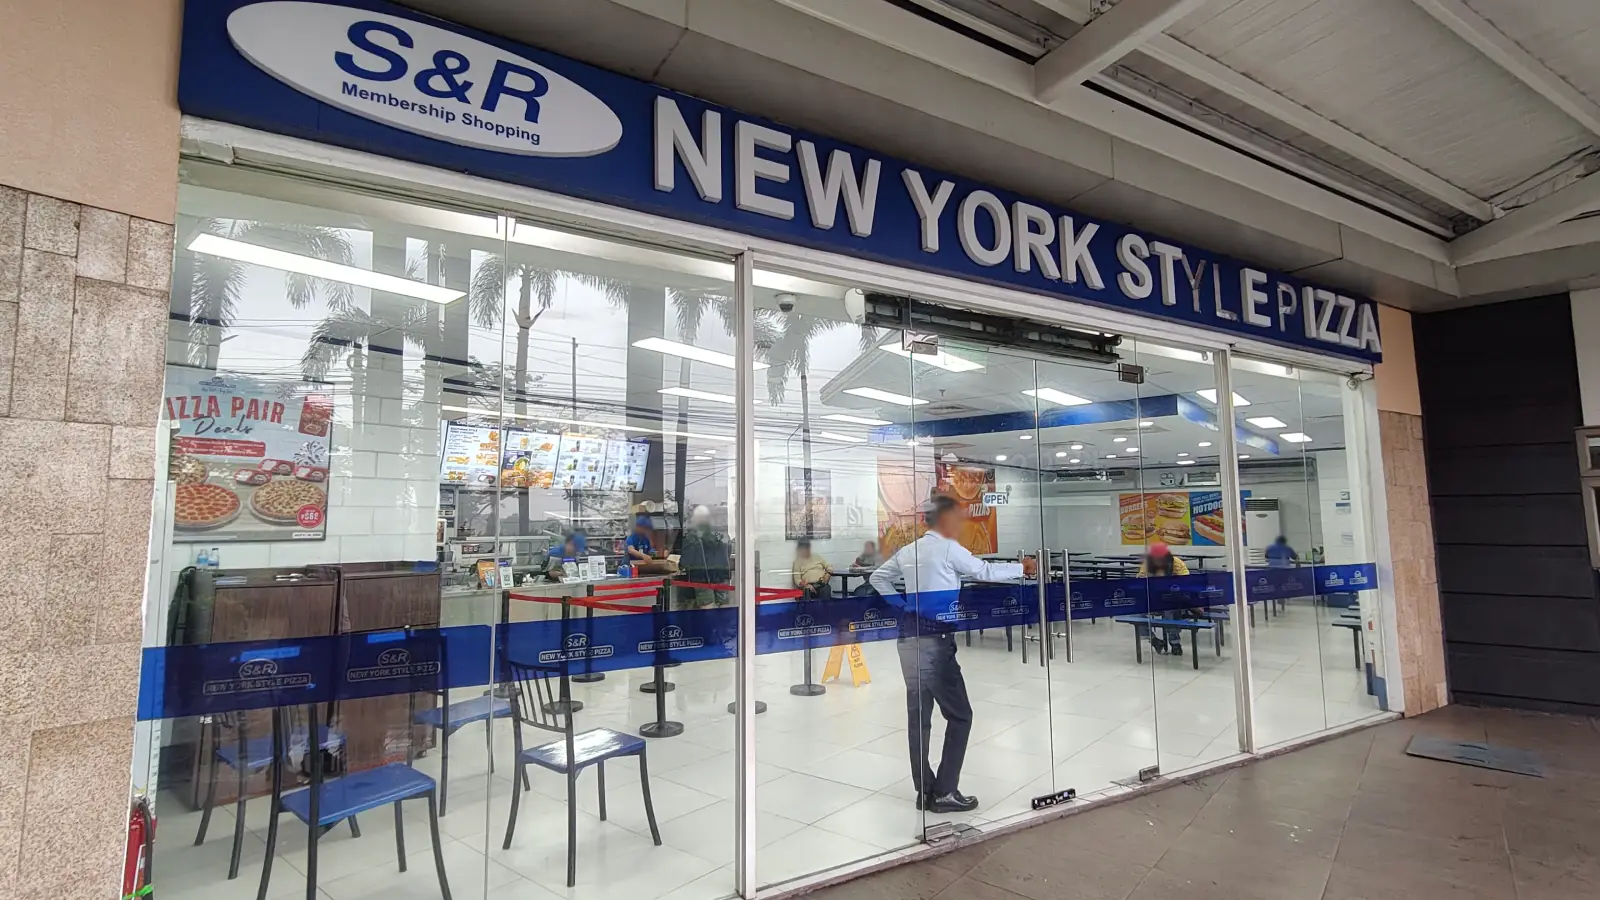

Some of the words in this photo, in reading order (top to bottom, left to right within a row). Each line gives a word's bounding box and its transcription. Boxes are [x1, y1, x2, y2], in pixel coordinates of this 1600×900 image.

[335, 20, 548, 124] S&R
[342, 81, 456, 123] Membership
[462, 112, 540, 145] Shopping
[654, 95, 881, 237] NEW
[901, 168, 1105, 290] YORK
[1116, 233, 1271, 327] STYLE
[1277, 281, 1382, 352] PIZZA
[165, 395, 220, 420] IZZA
[231, 396, 285, 424] PAIR
[192, 414, 253, 436] Deals
[567, 637, 587, 648] S&R
[381, 652, 408, 664] S&R
[541, 652, 555, 660] NEW
[594, 647, 611, 655] PIZZA
[242, 663, 275, 676] S&R
[369, 669, 390, 677] YORK
